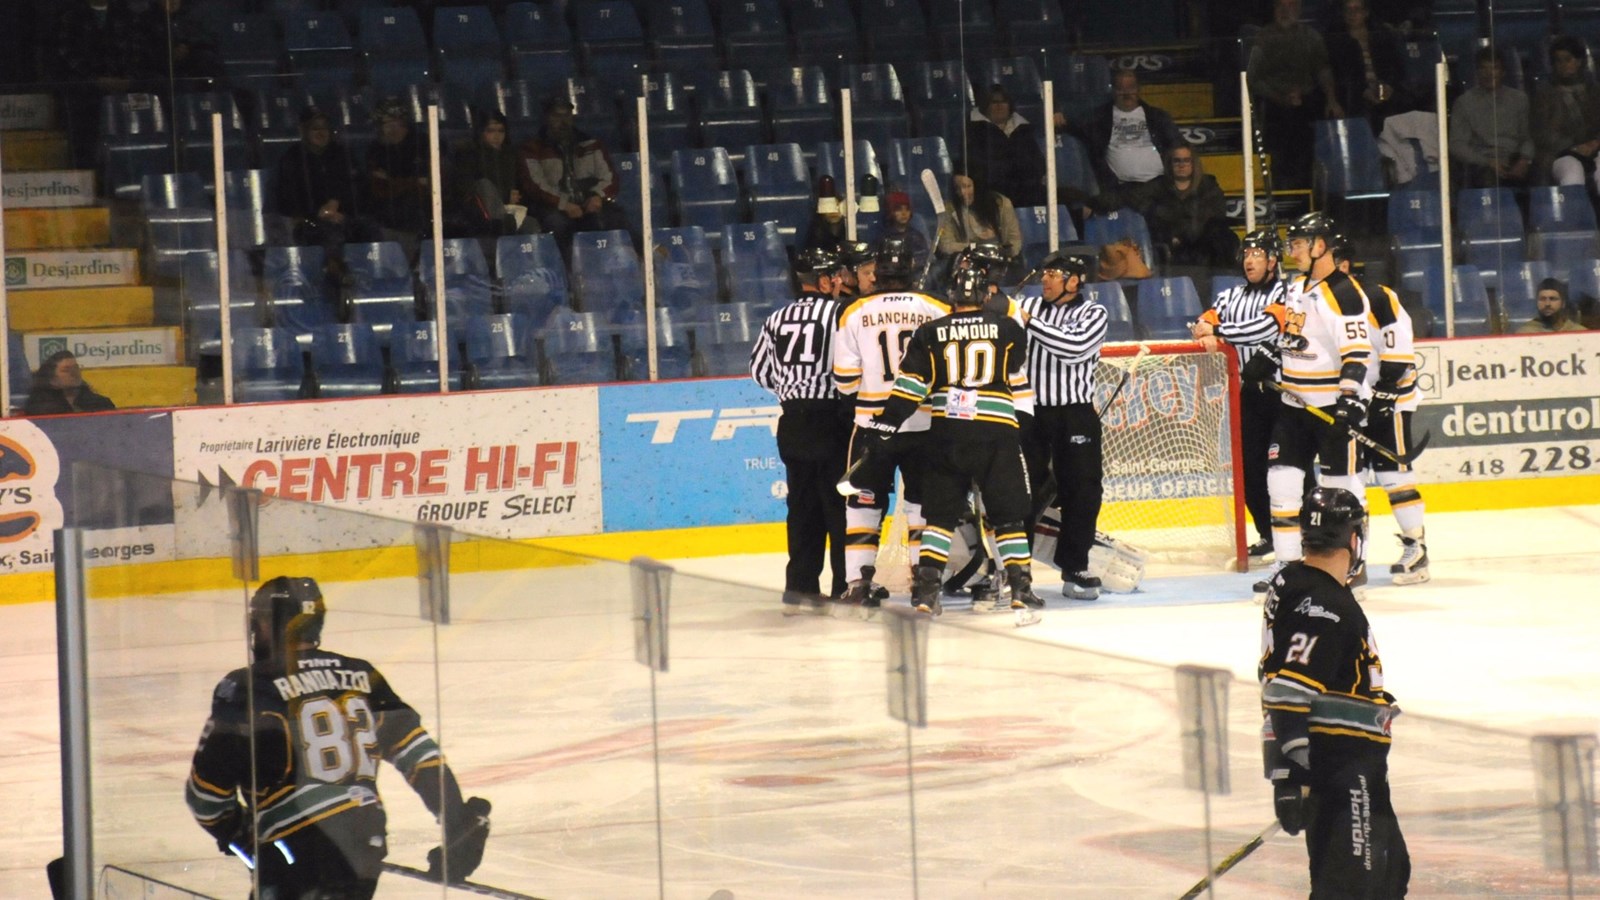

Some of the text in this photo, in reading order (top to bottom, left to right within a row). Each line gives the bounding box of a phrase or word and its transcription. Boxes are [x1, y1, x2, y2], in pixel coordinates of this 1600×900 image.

[596, 239, 607, 249] 37
[671, 235, 683, 245] 36
[743, 231, 756, 241] 35
[33, 259, 120, 280] Desjardins
[570, 320, 583, 331] 24
[719, 312, 731, 322] 22
[937, 323, 998, 342] D'AMOUR
[1345, 321, 1368, 340] 55
[74, 339, 162, 362] Desjardins
[780, 323, 816, 363] 71
[943, 340, 996, 388] 10
[1447, 353, 1587, 388] Jean-Rock
[256, 434, 322, 453] Larivière
[327, 429, 420, 450] Électronique
[744, 457, 786, 470] TRUE-
[1111, 458, 1204, 474] Saint-Georges
[1459, 458, 1505, 476] 418
[242, 441, 580, 507] CENTRE HI-FI
[417, 494, 576, 522] GROUPE SELECT
[1310, 511, 1322, 527] 21
[1285, 631, 1319, 666] 21
[273, 669, 372, 701] RANDAZZO
[298, 693, 381, 784] 82
